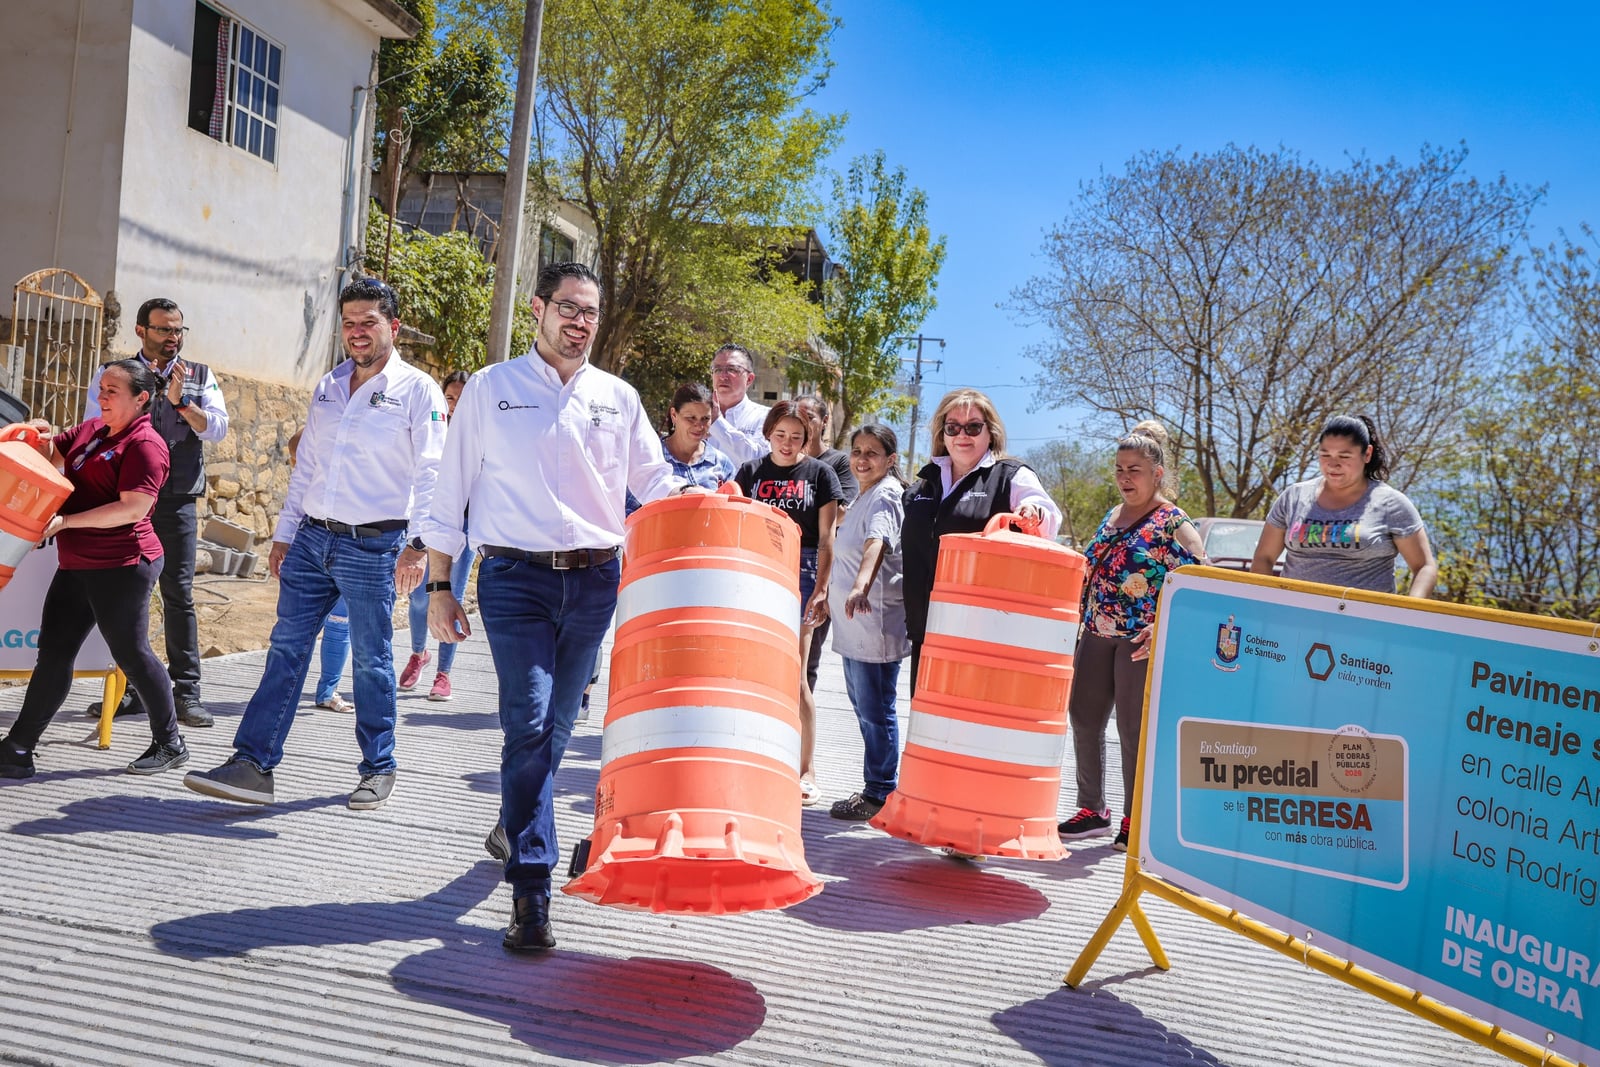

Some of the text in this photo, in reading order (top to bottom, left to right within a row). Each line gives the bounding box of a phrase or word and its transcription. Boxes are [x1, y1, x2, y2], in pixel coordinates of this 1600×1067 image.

[758, 480, 805, 499] GYM
[762, 498, 803, 510] EGACY
[1288, 520, 1361, 548] PERFECT
[1244, 645, 1286, 663] de Santiago
[1339, 653, 1393, 675] Santiago.
[1337, 670, 1391, 690] vida y orden
[1471, 661, 1600, 713] Pavimen
[1466, 705, 1581, 756] drenaje
[1200, 741, 1257, 759] En Santiago
[1335, 752, 1370, 760] DE OBRAS
[1342, 743, 1362, 751] PLAN
[1200, 757, 1318, 789] Tu predial
[1336, 759, 1370, 769] PÚBLICAS
[1461, 753, 1491, 779] en
[1501, 763, 1562, 797] calle
[1223, 796, 1373, 832] se te REGRESA
[1457, 795, 1600, 856] colonia Art
[1265, 829, 1378, 851] con más obra pública.
[1453, 830, 1597, 906] Los Rodríg
[1441, 937, 1584, 1021] DE OBRA
